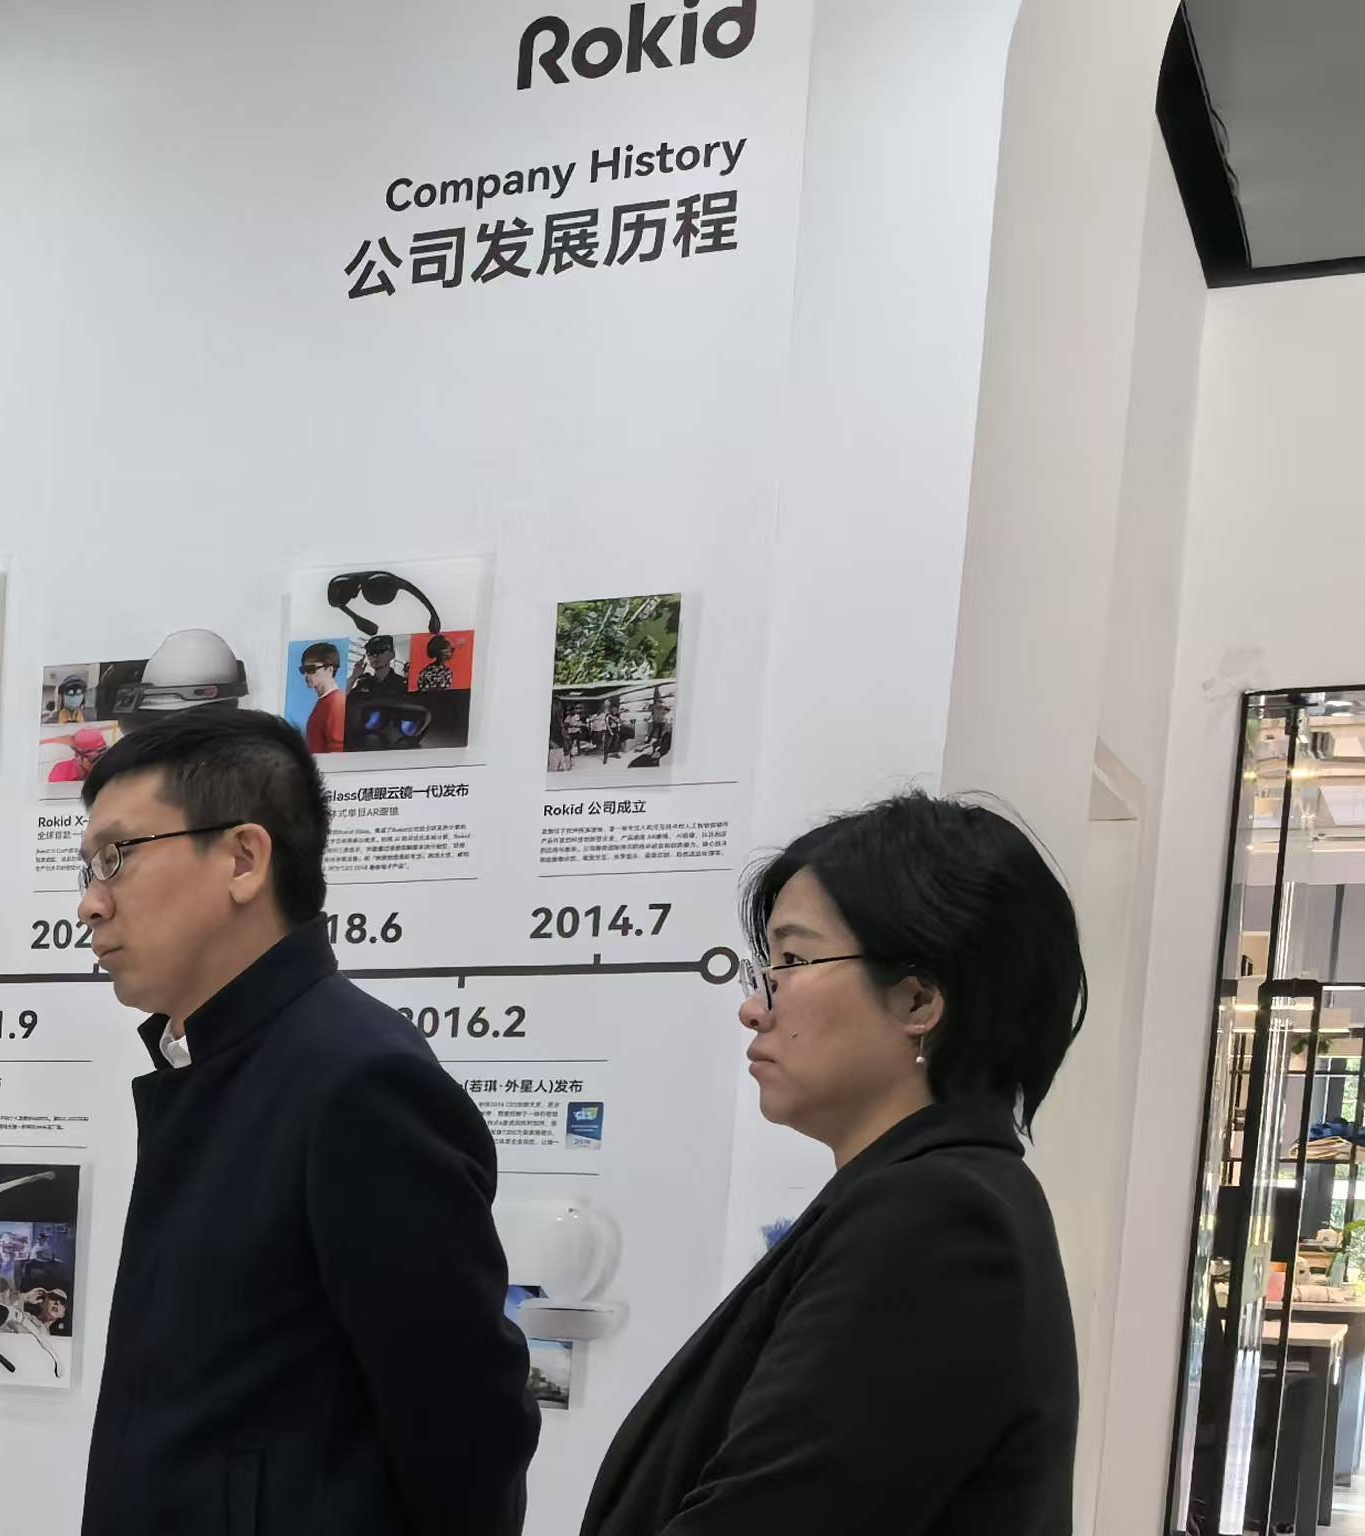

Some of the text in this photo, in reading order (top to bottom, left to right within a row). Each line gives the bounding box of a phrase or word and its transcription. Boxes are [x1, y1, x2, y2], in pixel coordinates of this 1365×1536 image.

[517, 0, 757, 90] Rokid
[386, 138, 747, 212] Company History
[344, 190, 738, 299] 公司发展历程
[38, 816, 72, 828] Rokid
[543, 800, 646, 816] Rokid 公司成立
[530, 903, 672, 939] 2014.7
[462, 1079, 583, 1093] (若琪·外星人)发布
